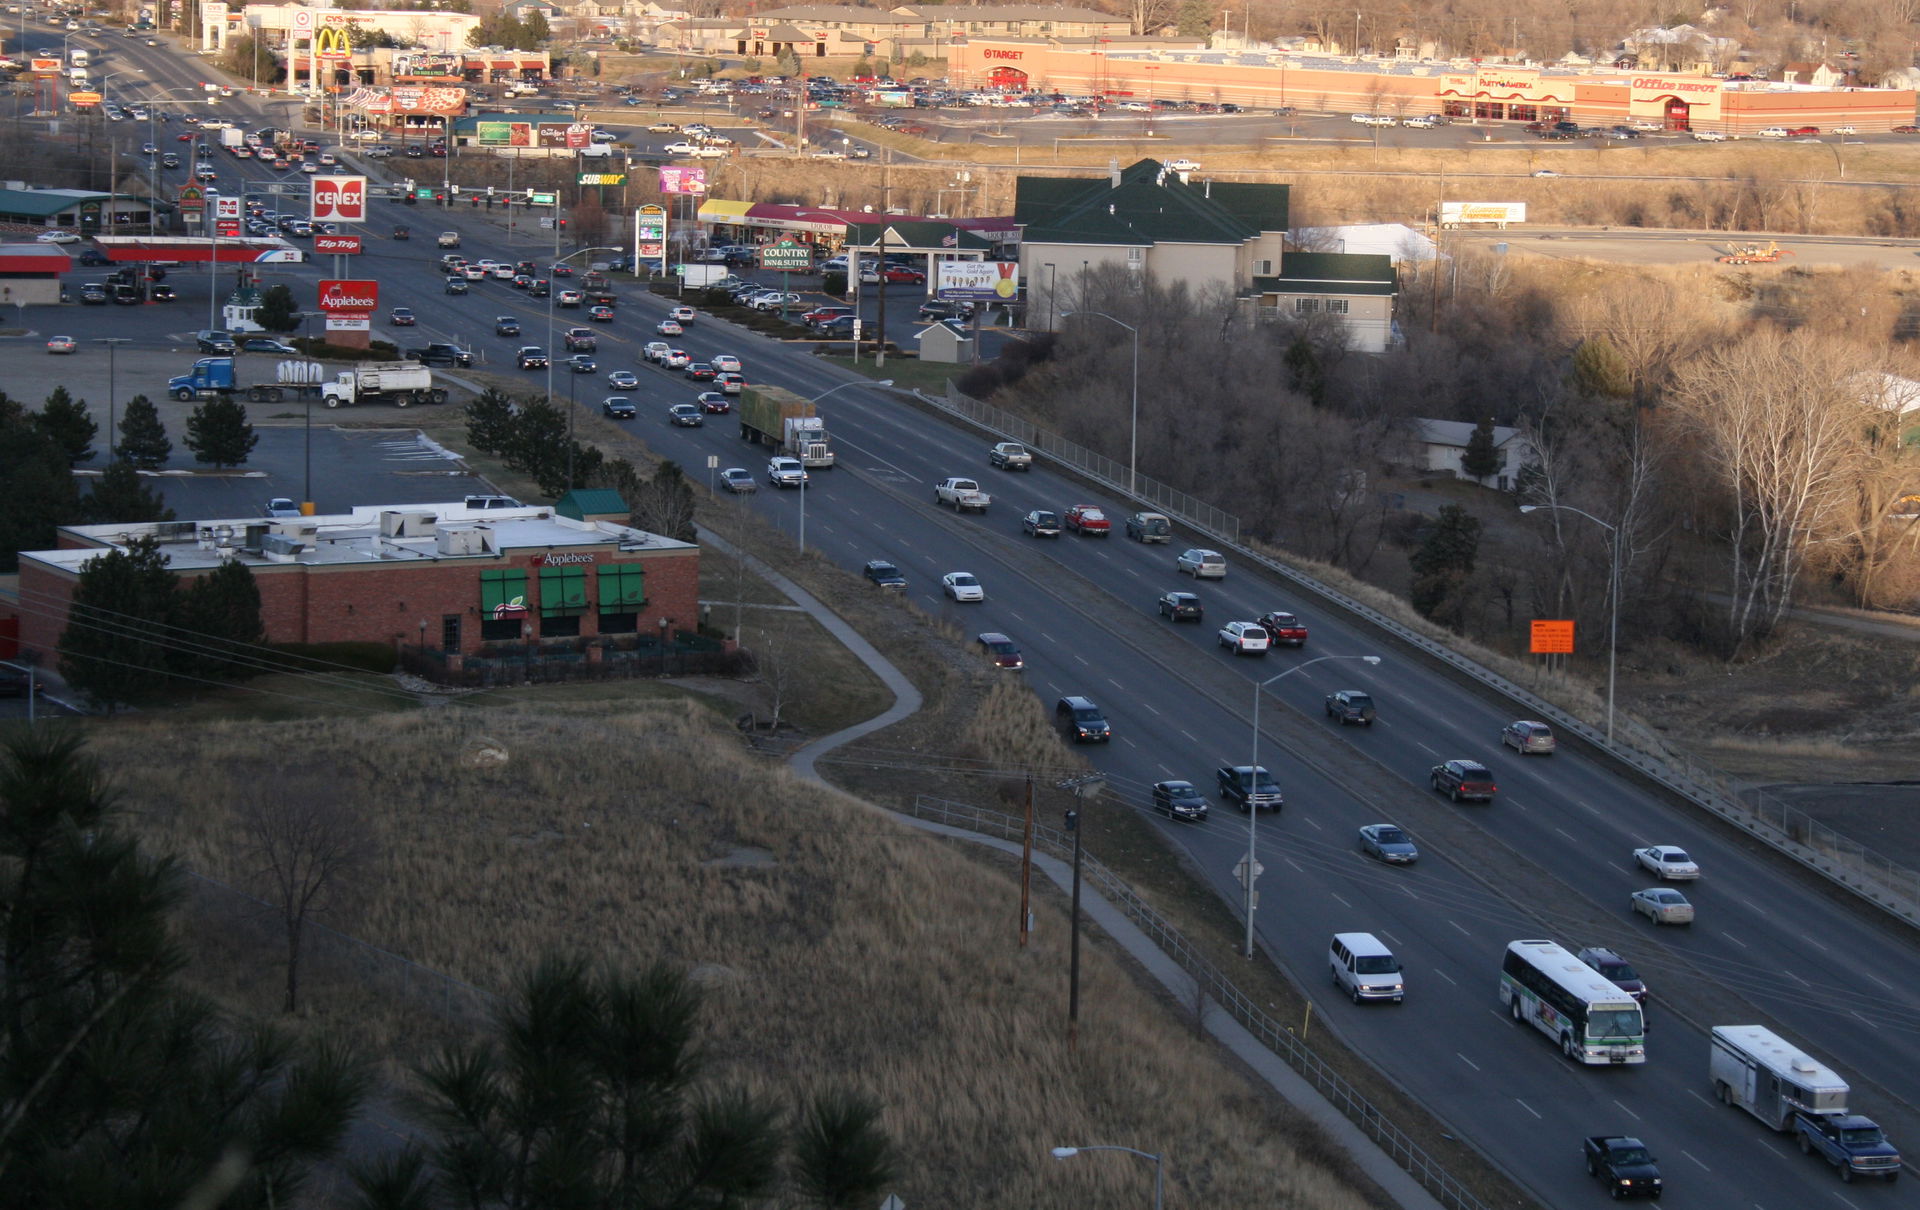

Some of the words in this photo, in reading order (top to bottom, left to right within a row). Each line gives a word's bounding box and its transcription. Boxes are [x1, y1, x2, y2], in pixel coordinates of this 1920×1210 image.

[992, 50, 1024, 60] TARGET
[1479, 78, 1500, 87] PARTY
[1504, 80, 1533, 89] AMERICA
[1632, 78, 1677, 90] Office
[1677, 82, 1717, 93] DEPOT
[579, 174, 625, 185] SUBWAY
[315, 191, 361, 206] CENEX
[810, 222, 833, 231] LIQUOR
[318, 239, 337, 248] Zip
[337, 240, 358, 249] Trip
[763, 248, 809, 257] COUNTRY
[784, 259, 809, 267] SUITES
[321, 293, 374, 308] Applebee's
[544, 552, 593, 566] Applebee's
